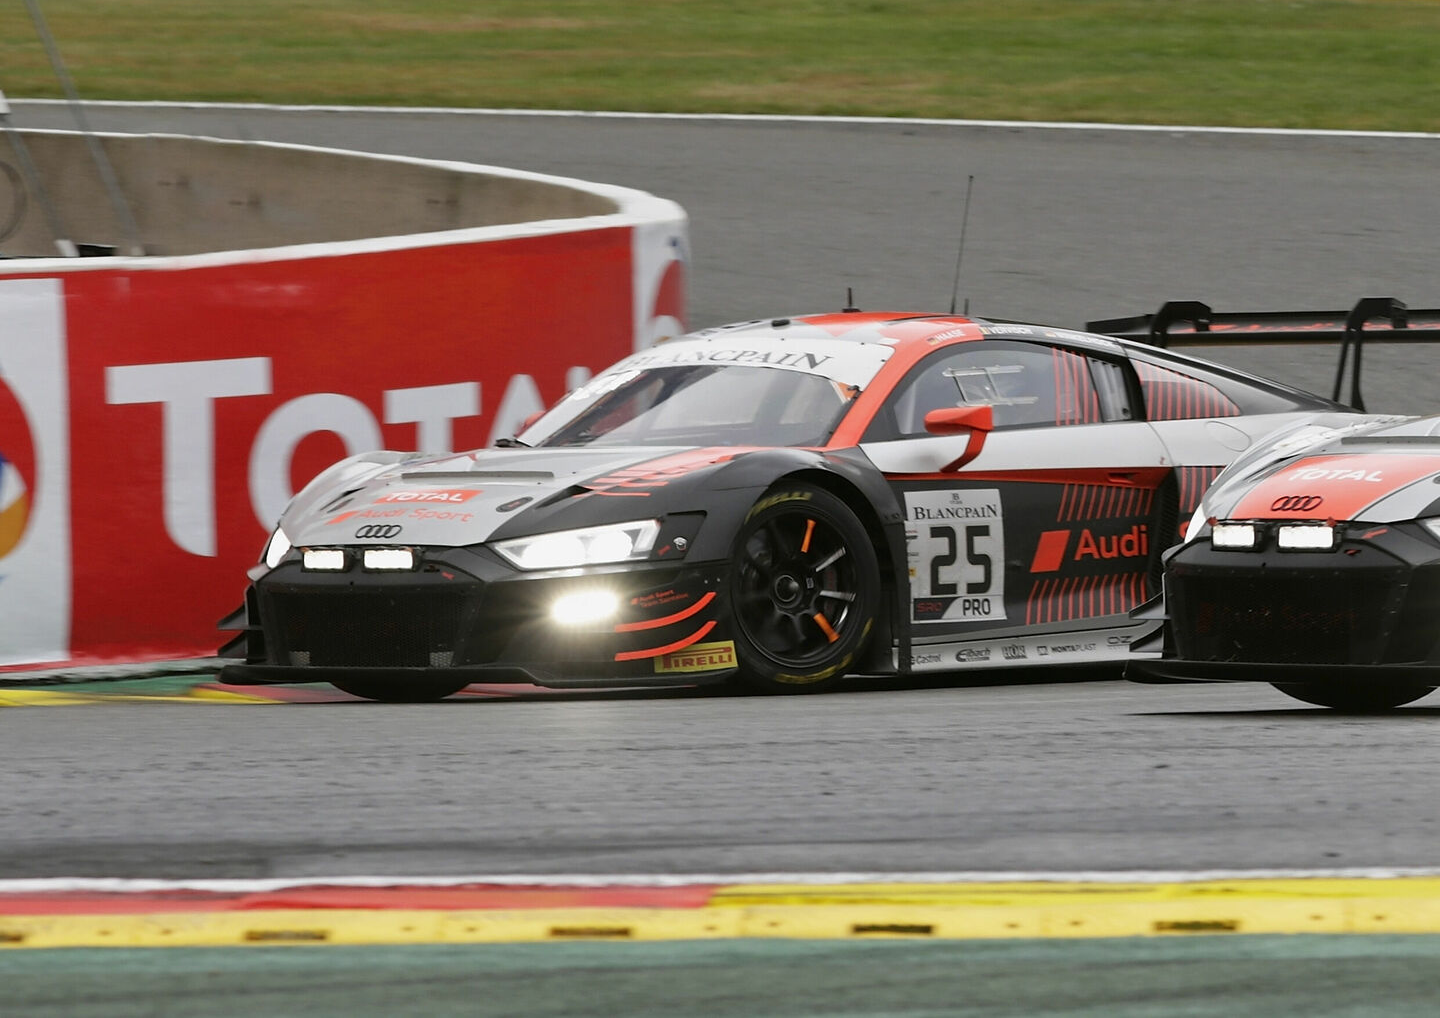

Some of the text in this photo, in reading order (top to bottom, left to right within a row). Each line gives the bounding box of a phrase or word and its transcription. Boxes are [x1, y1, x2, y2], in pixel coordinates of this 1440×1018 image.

[104, 355, 596, 558] TOT
[1288, 468, 1383, 482] TOTAL
[386, 490, 465, 502] TOTAL
[408, 508, 474, 522] Sport
[912, 504, 998, 520] BLANCPAIN
[1074, 524, 1148, 560] Audi
[930, 525, 992, 595] 25
[963, 598, 991, 616] PRO
[662, 646, 733, 669] PIRELLI
